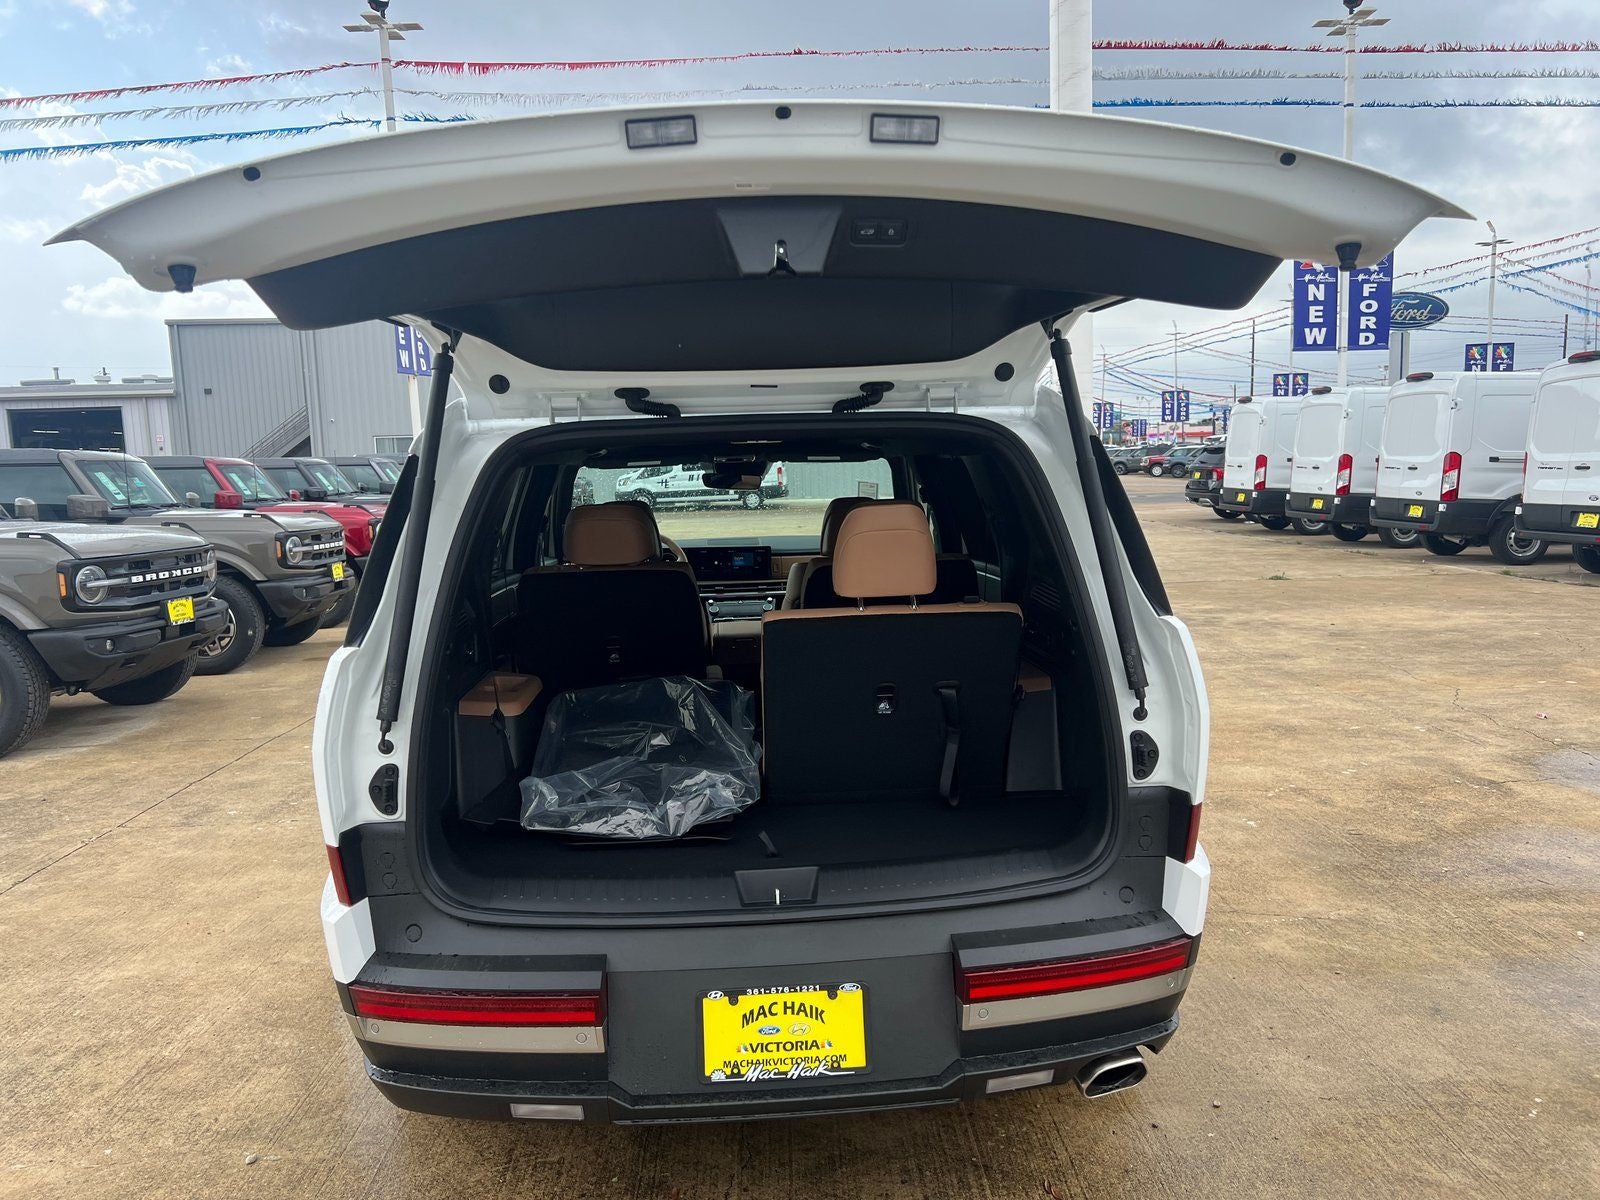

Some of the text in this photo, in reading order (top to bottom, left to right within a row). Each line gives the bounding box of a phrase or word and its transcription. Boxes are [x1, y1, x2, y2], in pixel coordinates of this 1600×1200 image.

[1304, 284, 1326, 344] NEW
[1358, 284, 1378, 346] FORD
[1391, 300, 1432, 320] Ford
[398, 326, 410, 368] EW
[131, 566, 202, 583] BRONCO
[746, 984, 820, 996] 361-576-1221
[742, 1001, 826, 1028] MAC HAIK
[750, 1040, 820, 1053] VICTORIA
[723, 1054, 847, 1068] MACHAIKVICTORIACOM
[743, 1064, 786, 1082] Mac
